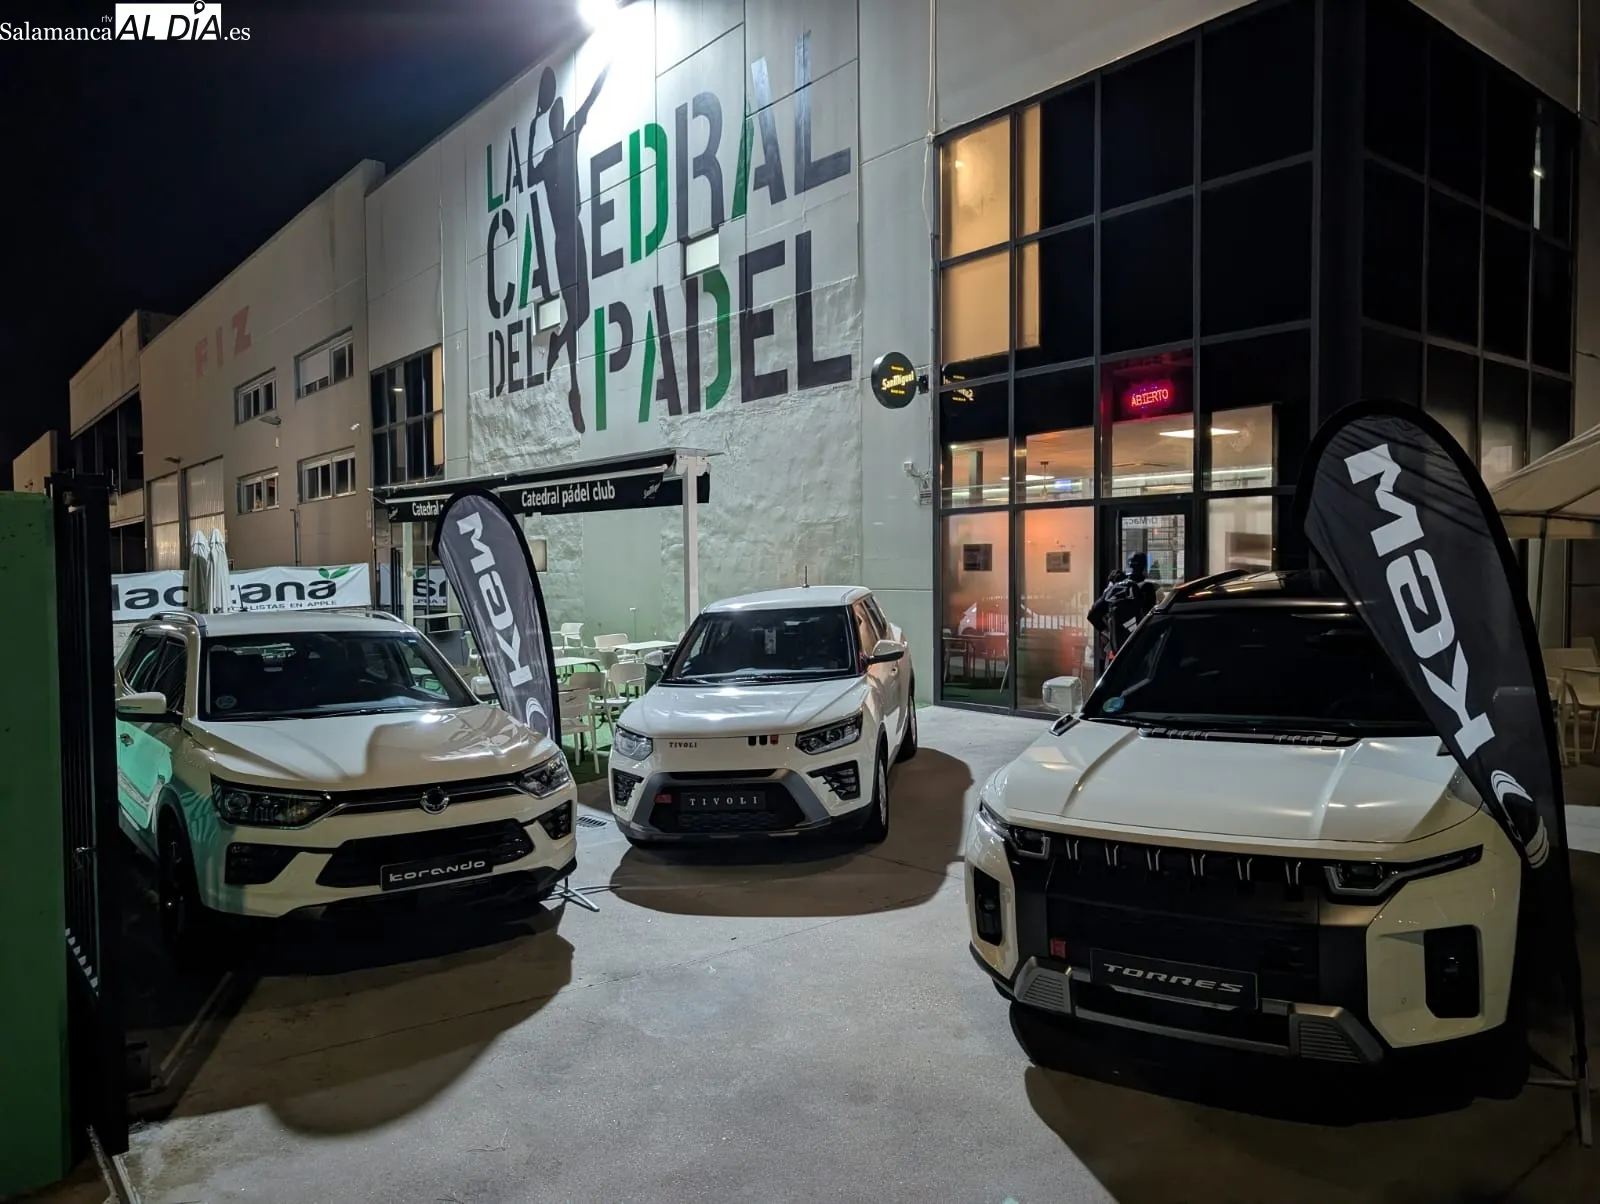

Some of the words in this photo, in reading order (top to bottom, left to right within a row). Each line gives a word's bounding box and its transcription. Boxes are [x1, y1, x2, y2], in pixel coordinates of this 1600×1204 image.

[487, 127, 522, 213] LA
[594, 230, 852, 431] PADEL
[488, 317, 545, 398] DEL
[1132, 388, 1169, 407] ABIERTO
[412, 500, 440, 516] Catedral
[521, 486, 561, 508] Catedral
[562, 483, 590, 508] pádel
[592, 480, 616, 501] club
[689, 796, 759, 806] TIVOLI
[1103, 963, 1244, 992] TORRES
